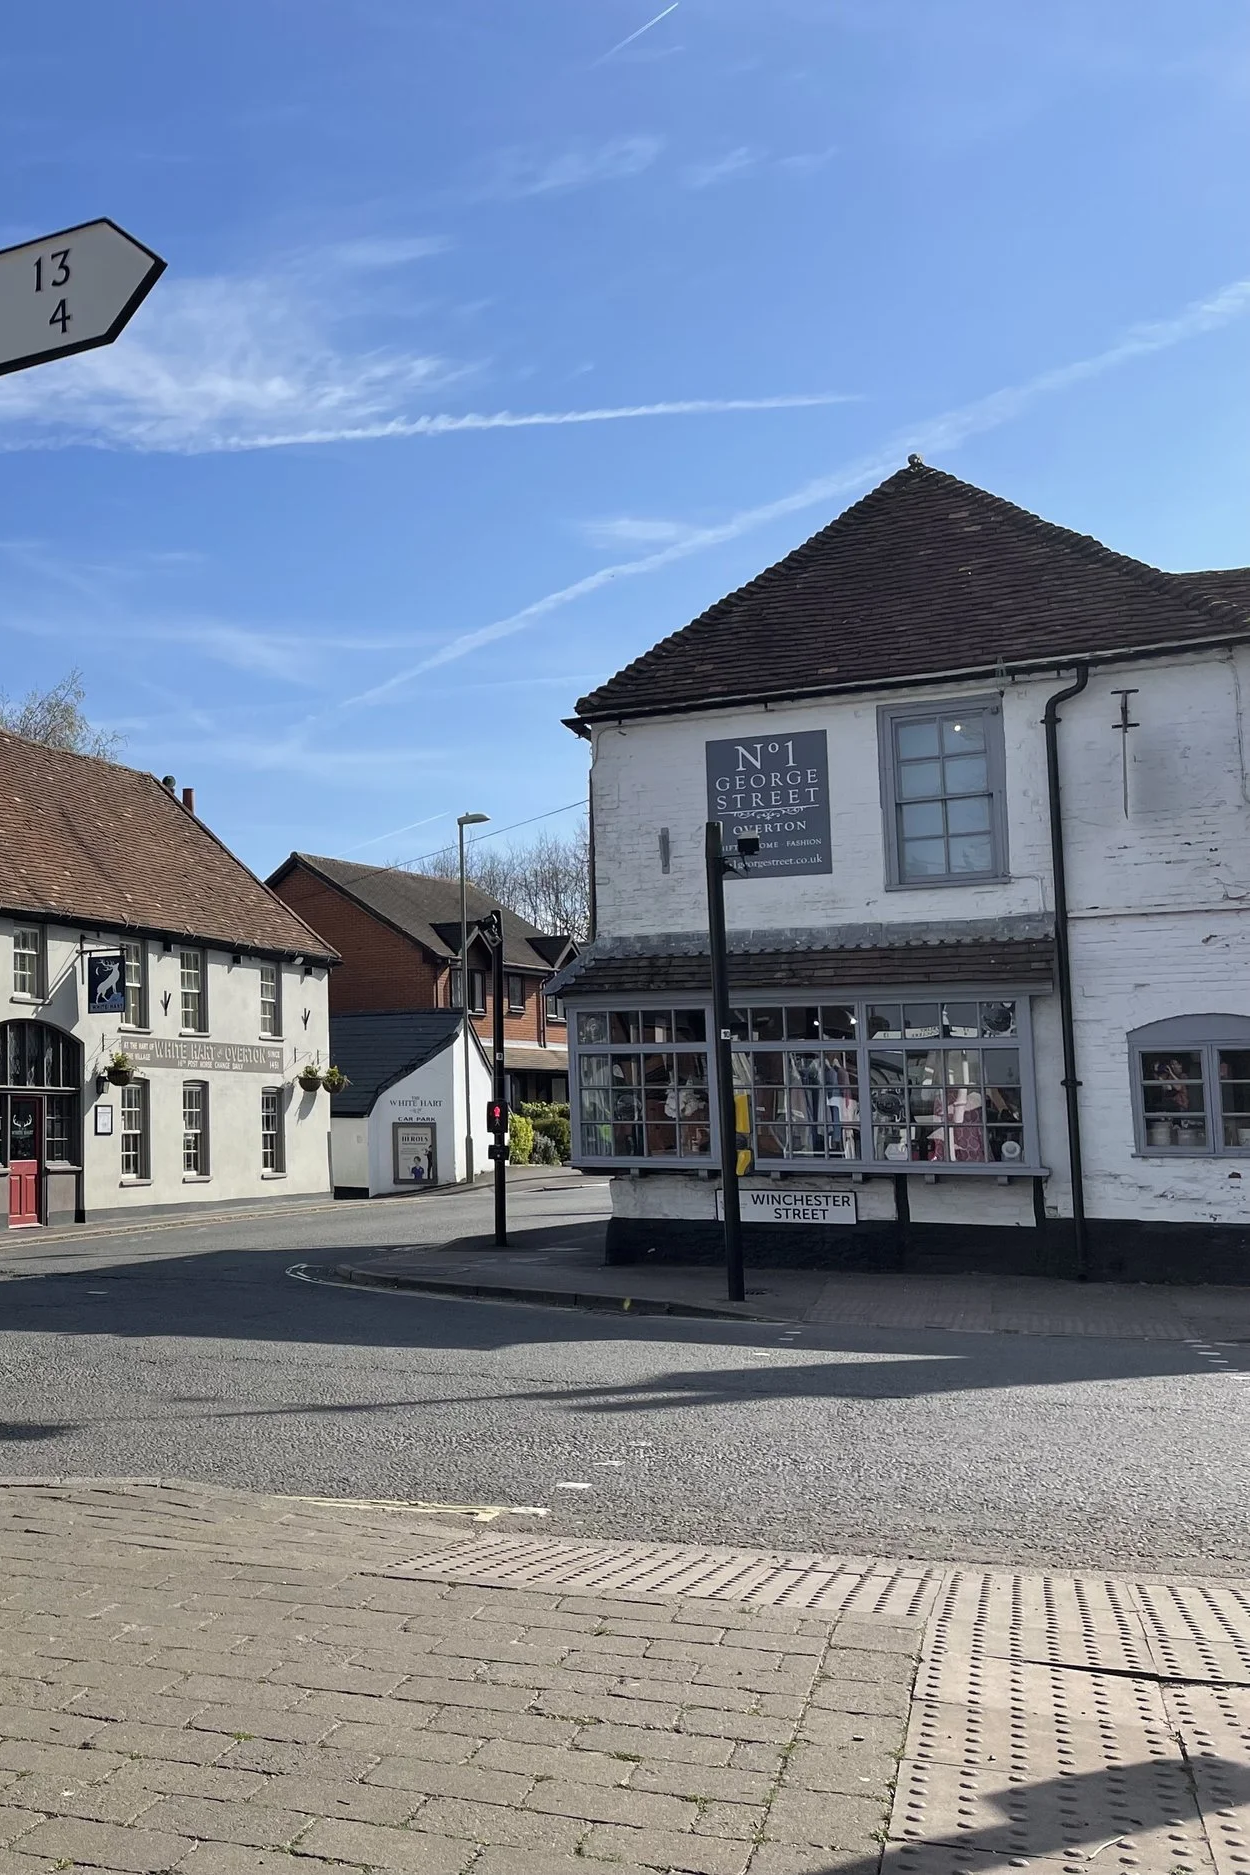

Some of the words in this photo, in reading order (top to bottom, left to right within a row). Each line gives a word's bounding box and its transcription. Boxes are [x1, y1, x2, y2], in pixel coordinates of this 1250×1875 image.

[33, 248, 71, 293] 13
[48, 298, 72, 334] 4
[716, 769, 819, 792] GEORGE
[717, 787, 819, 810] STREET
[733, 820, 807, 836] OVERTON
[759, 841, 779, 849] OME
[786, 838, 822, 847] FASHION
[154, 1041, 187, 1059] WHITE
[191, 1043, 216, 1060] HART
[225, 1046, 266, 1064] OVERTON
[268, 1050, 280, 1059] SINCE
[750, 1193, 851, 1207] WINCHESTER
[774, 1208, 829, 1220] STREET
